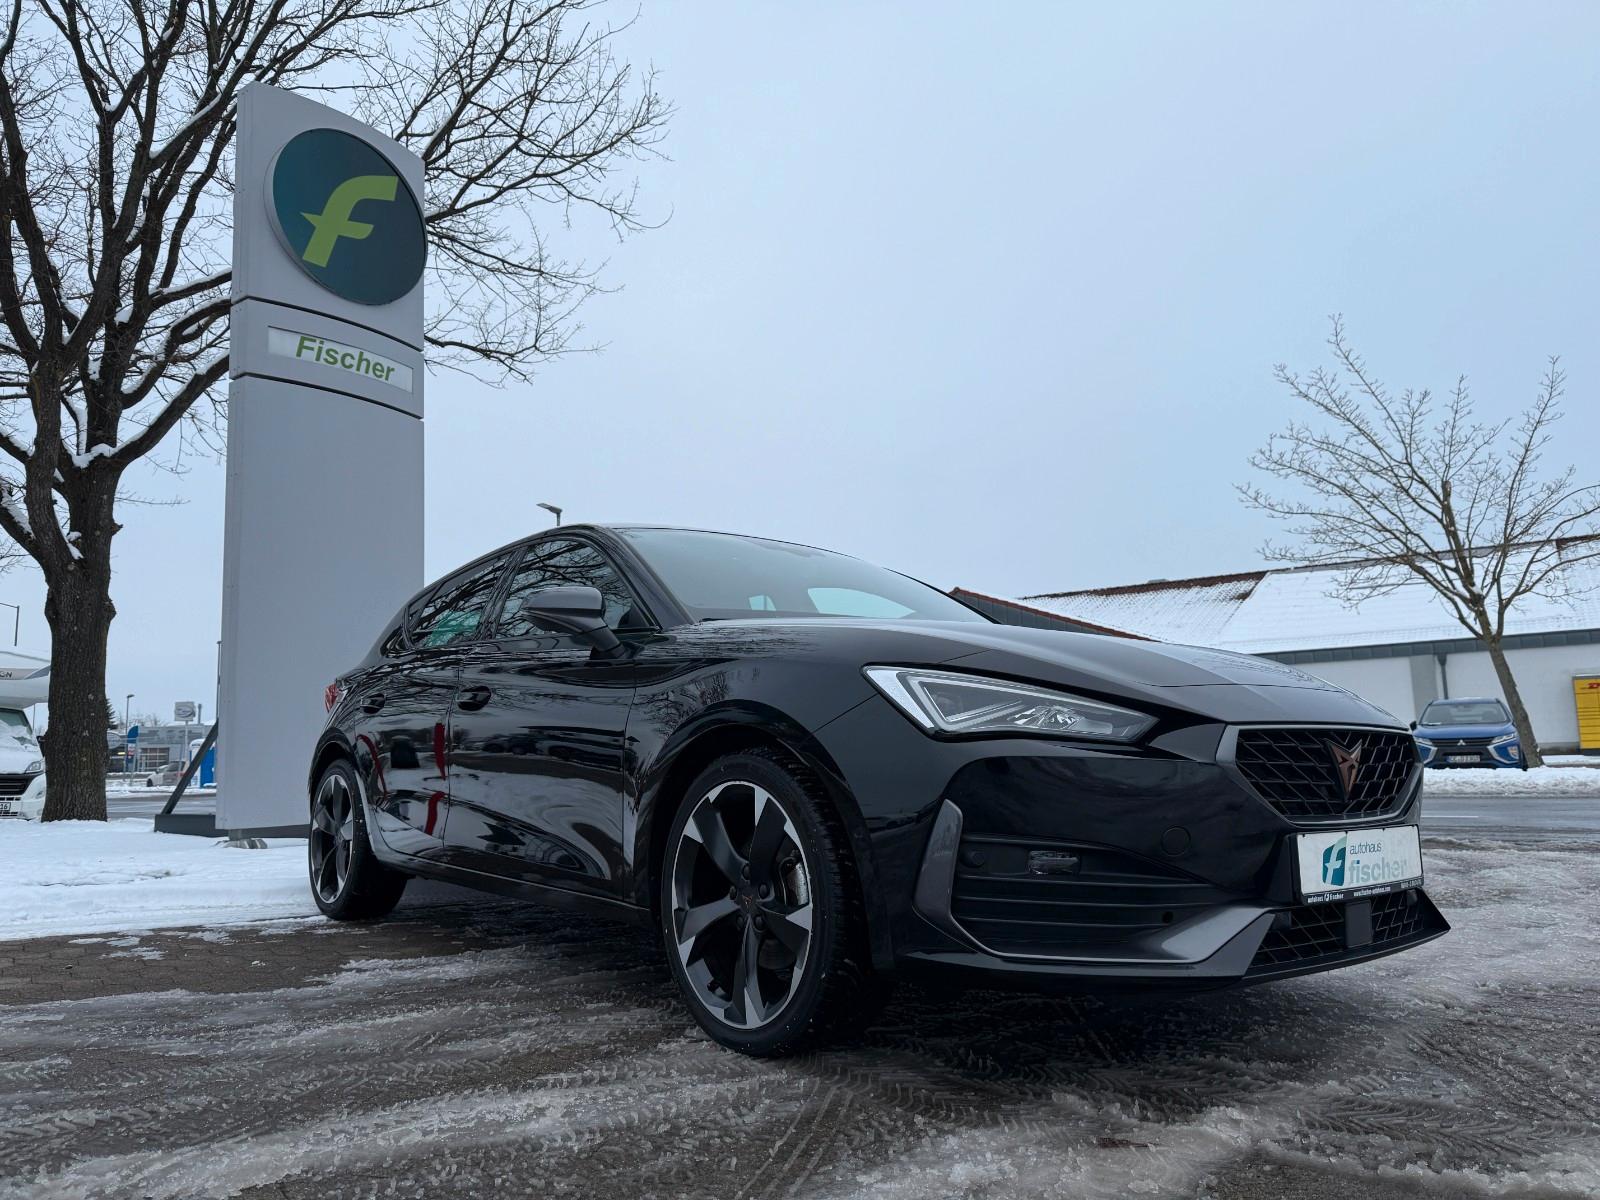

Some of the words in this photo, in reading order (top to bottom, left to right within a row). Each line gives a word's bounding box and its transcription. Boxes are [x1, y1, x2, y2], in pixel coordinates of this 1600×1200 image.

[296, 335, 395, 381] Fischer
[1349, 841, 1382, 855] autohaus
[1348, 857, 1408, 884] fischer
